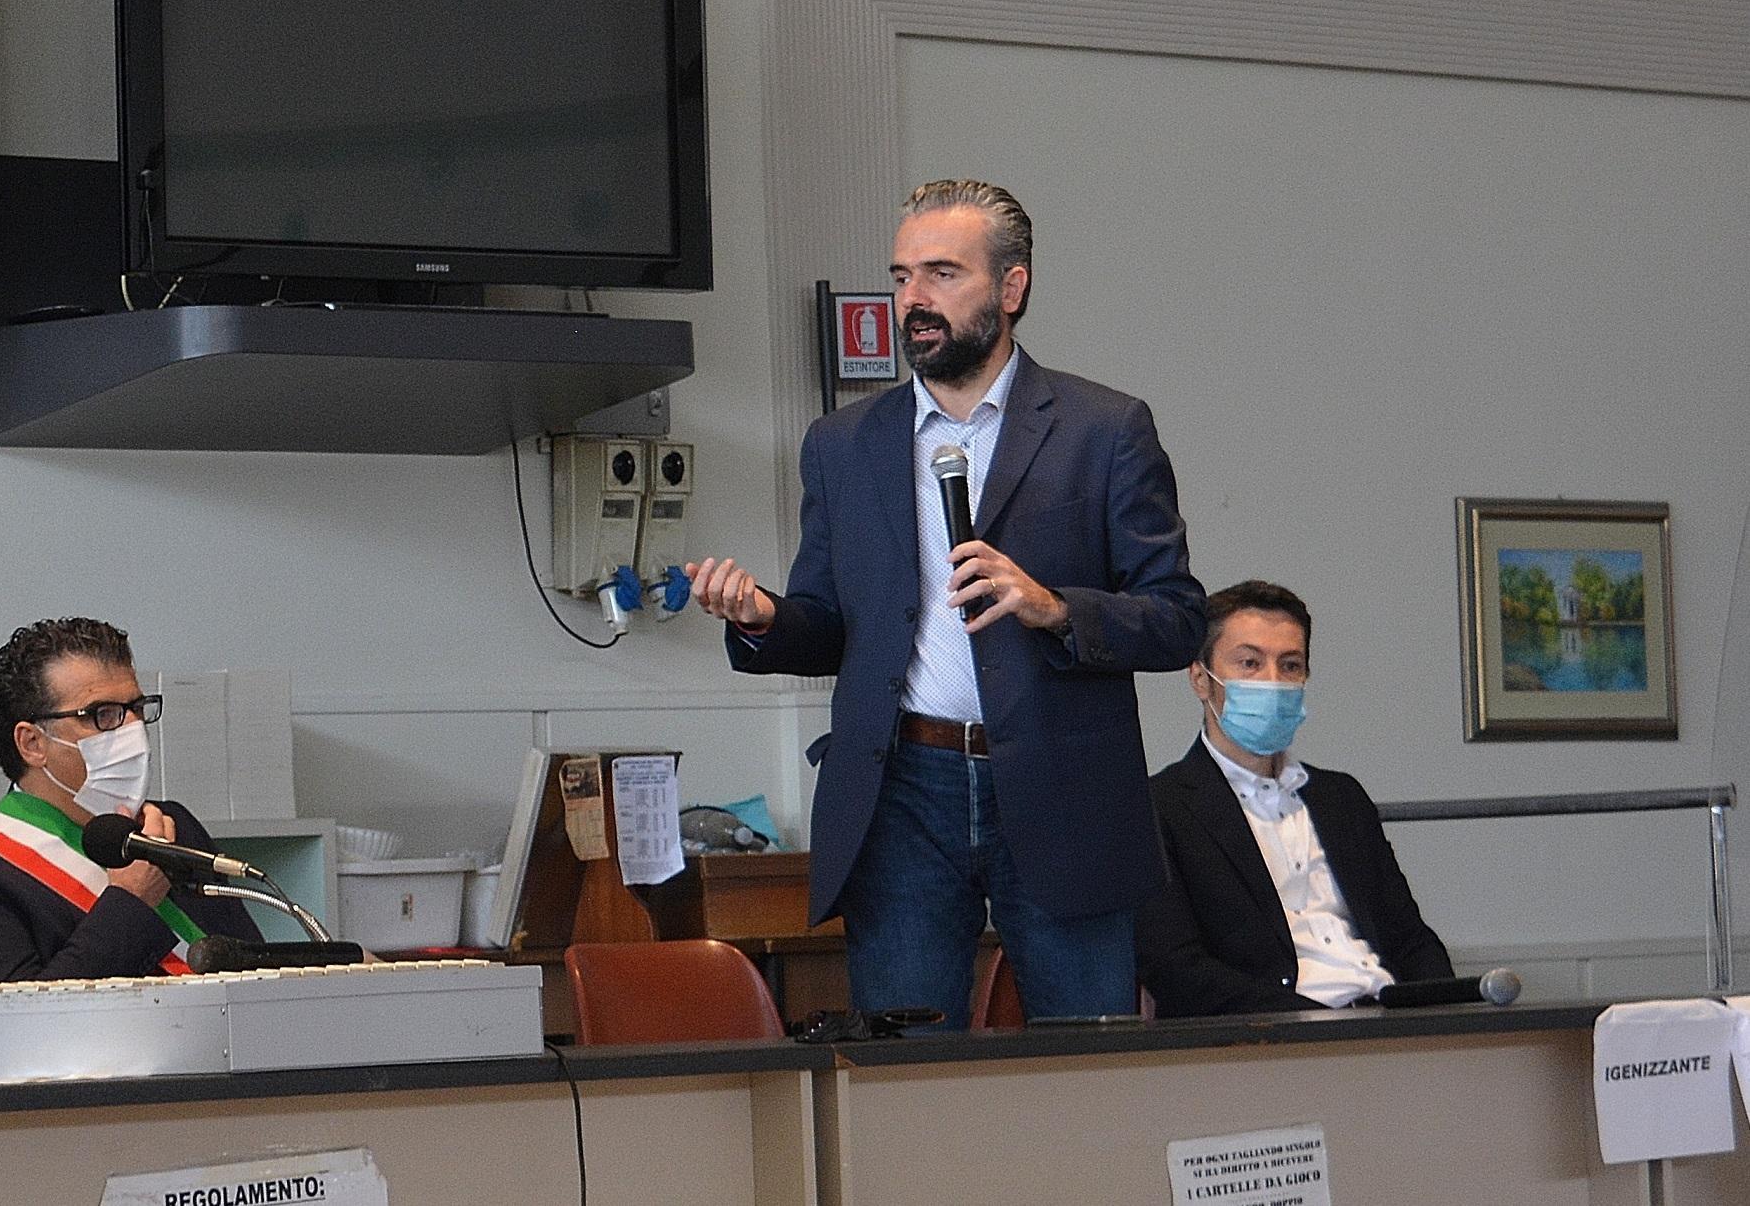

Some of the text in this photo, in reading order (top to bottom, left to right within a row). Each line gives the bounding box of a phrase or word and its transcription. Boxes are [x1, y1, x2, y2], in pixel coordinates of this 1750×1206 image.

[415, 263, 449, 272] SAMSUNG
[843, 361, 891, 373] ESTINTORE
[1605, 1055, 1711, 1082] IGENIZZANTE
[1184, 1140, 1321, 1167] PER OGNI TAGLIANDO SINGOLO
[1193, 1168, 1202, 1178] SI
[1205, 1167, 1219, 1177] HA
[1221, 1162, 1260, 1175] DIRITTO
[1271, 1154, 1314, 1168] RICEVERE
[164, 1176, 326, 1206] REGOLAMENTO:
[1196, 1178, 1261, 1200] CARTELLE
[1265, 1176, 1283, 1189] DA
[1285, 1169, 1321, 1186] GIOCO
